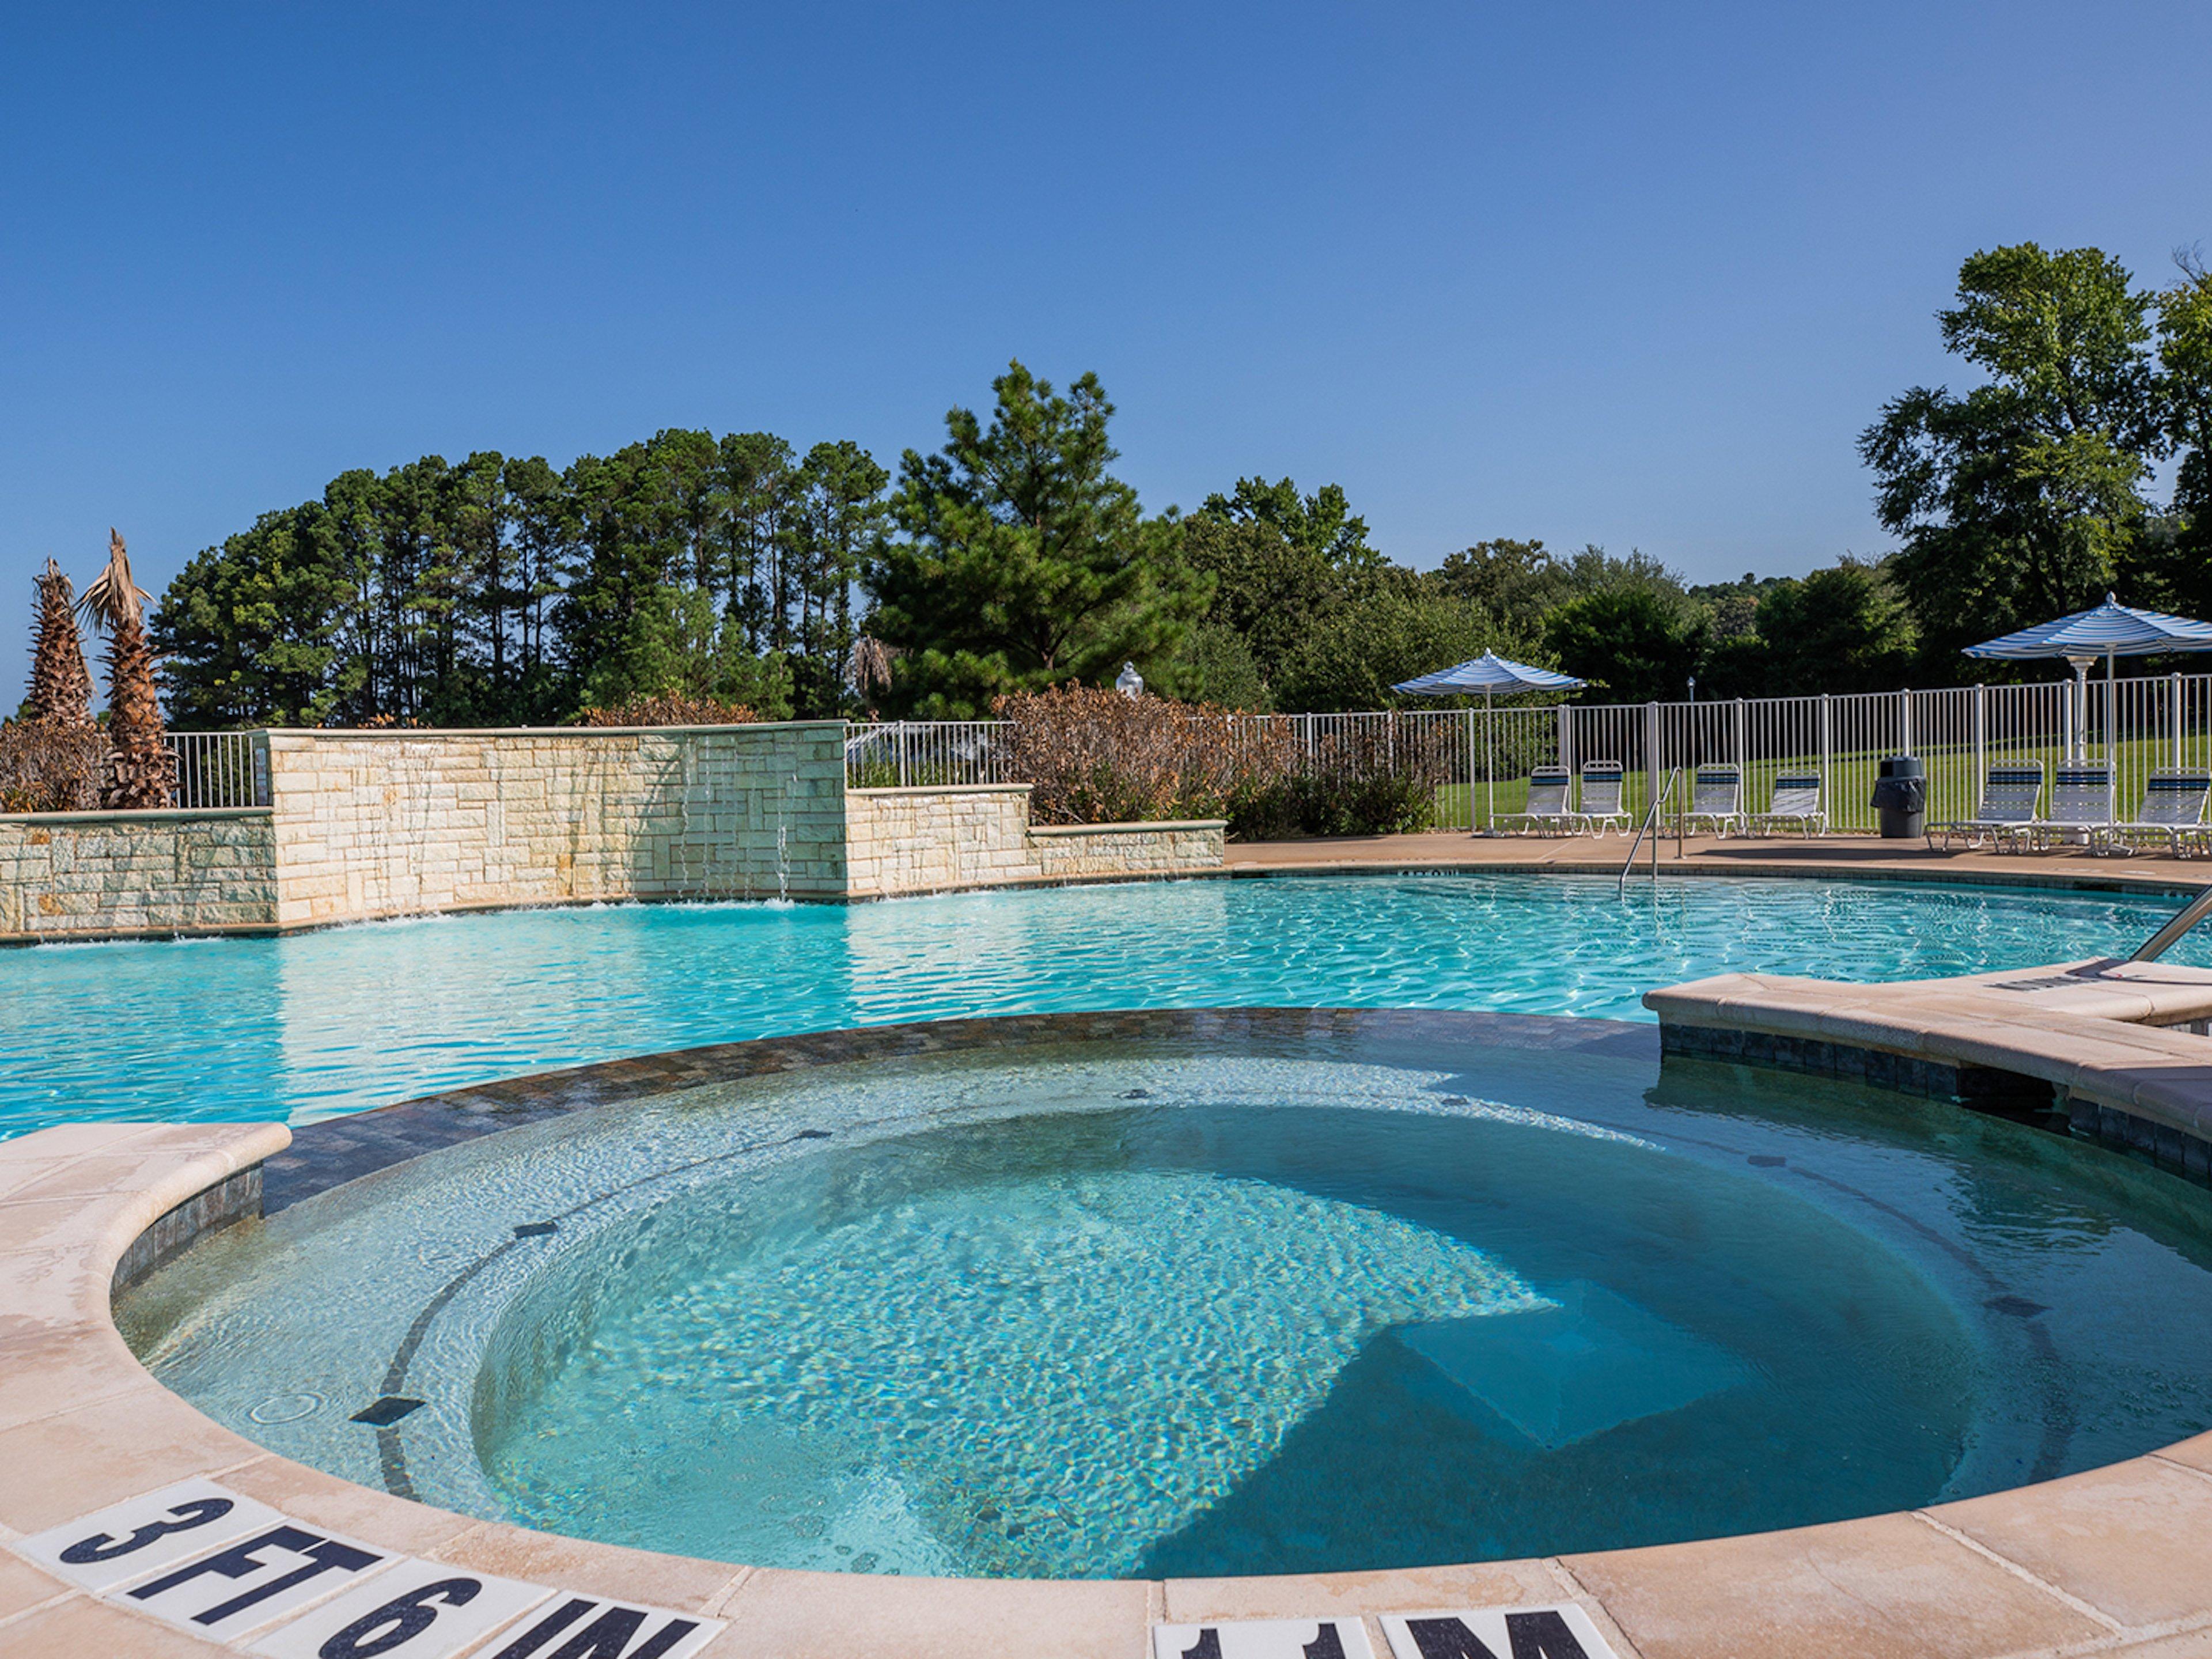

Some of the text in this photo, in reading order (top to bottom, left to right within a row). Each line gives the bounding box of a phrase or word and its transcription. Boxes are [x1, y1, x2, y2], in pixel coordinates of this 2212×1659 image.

[60, 1499, 699, 1659] 3 FT 6 IN
[1406, 1611, 1589, 1659] M
